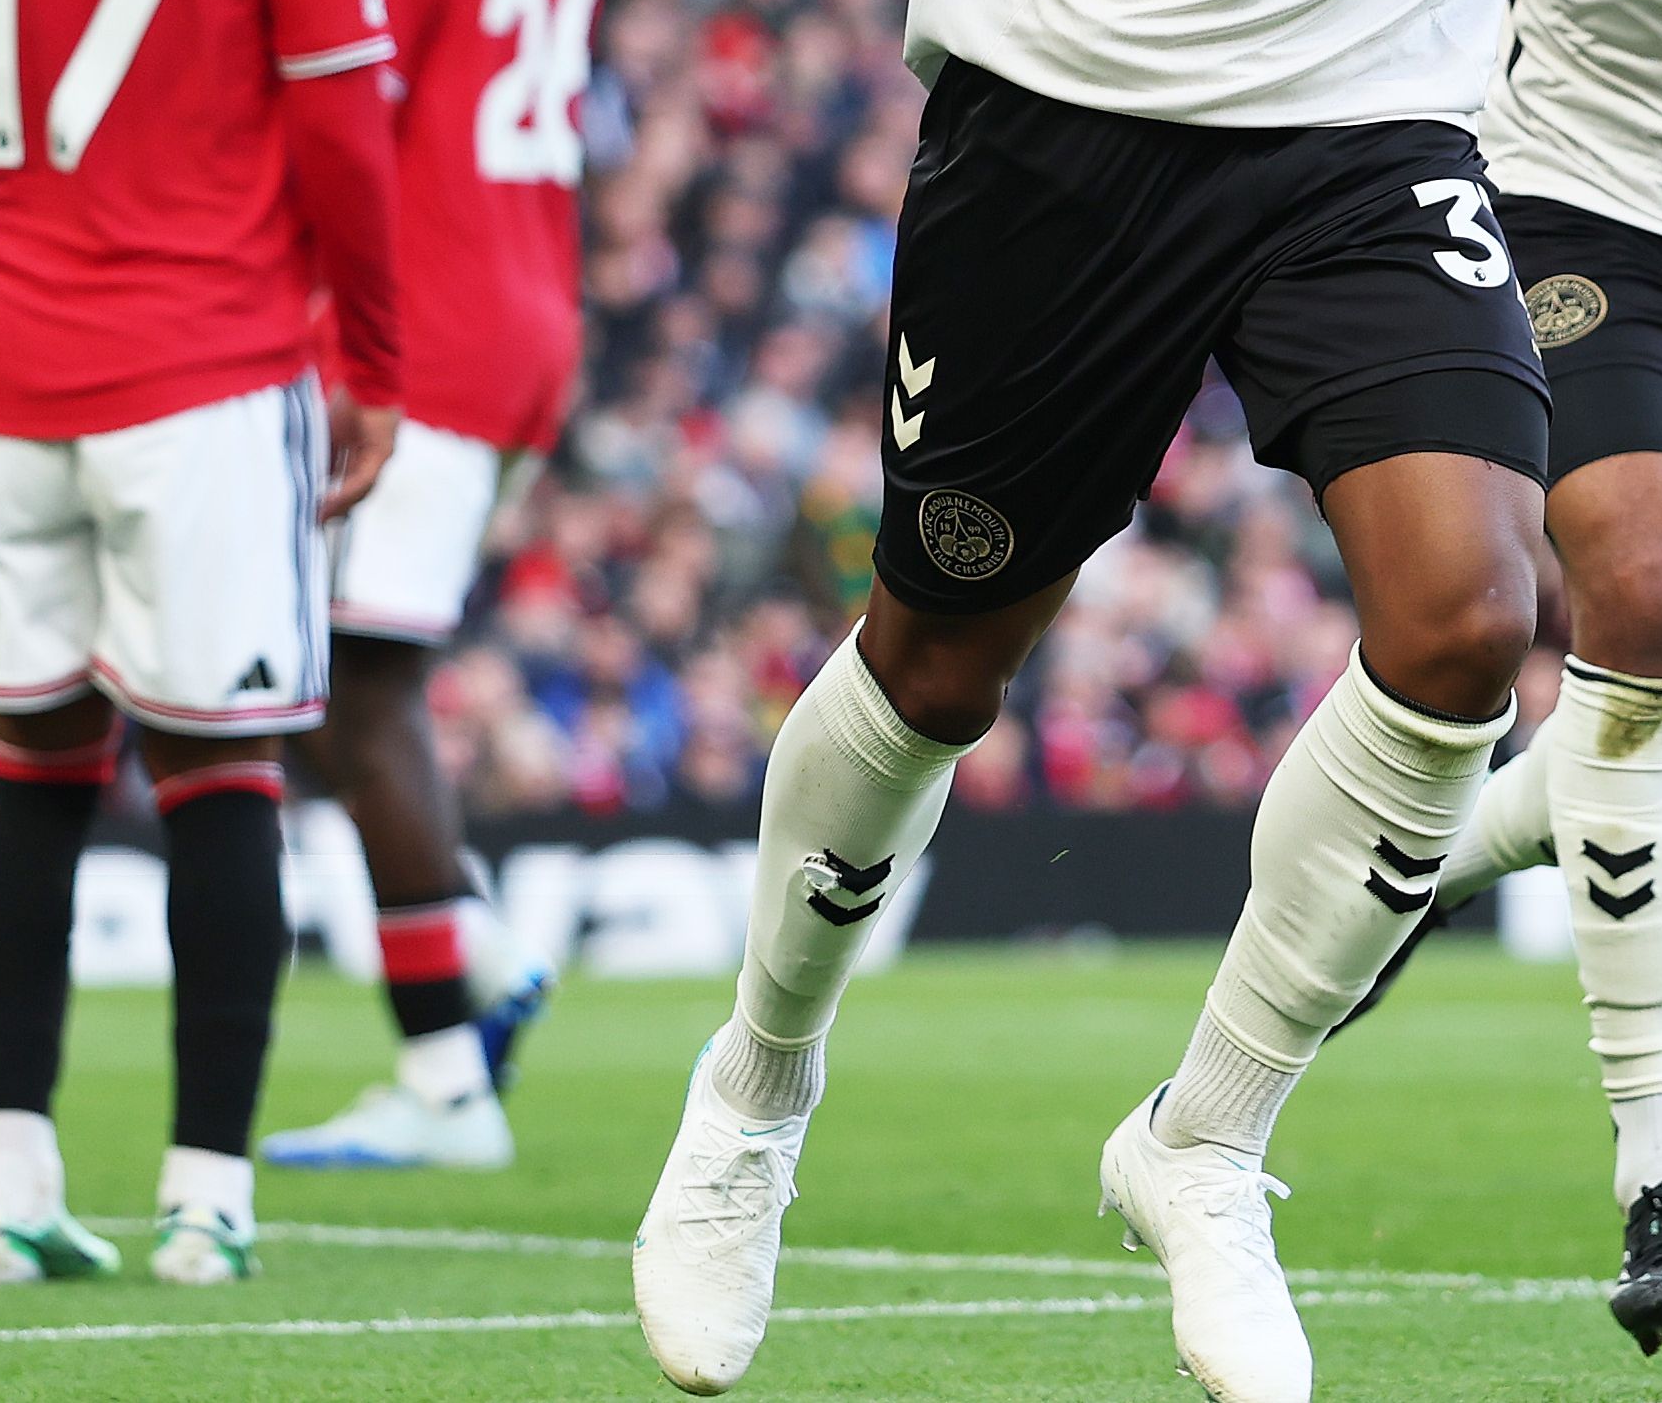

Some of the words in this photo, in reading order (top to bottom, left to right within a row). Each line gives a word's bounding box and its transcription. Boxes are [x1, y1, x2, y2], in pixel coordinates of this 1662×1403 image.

[924, 512, 934, 537] AFC
[927, 496, 1006, 540] BOURNEMOUTH
[939, 522, 951, 533] 18
[933, 548, 952, 568] THE
[954, 550, 1004, 574] CHERRIES
